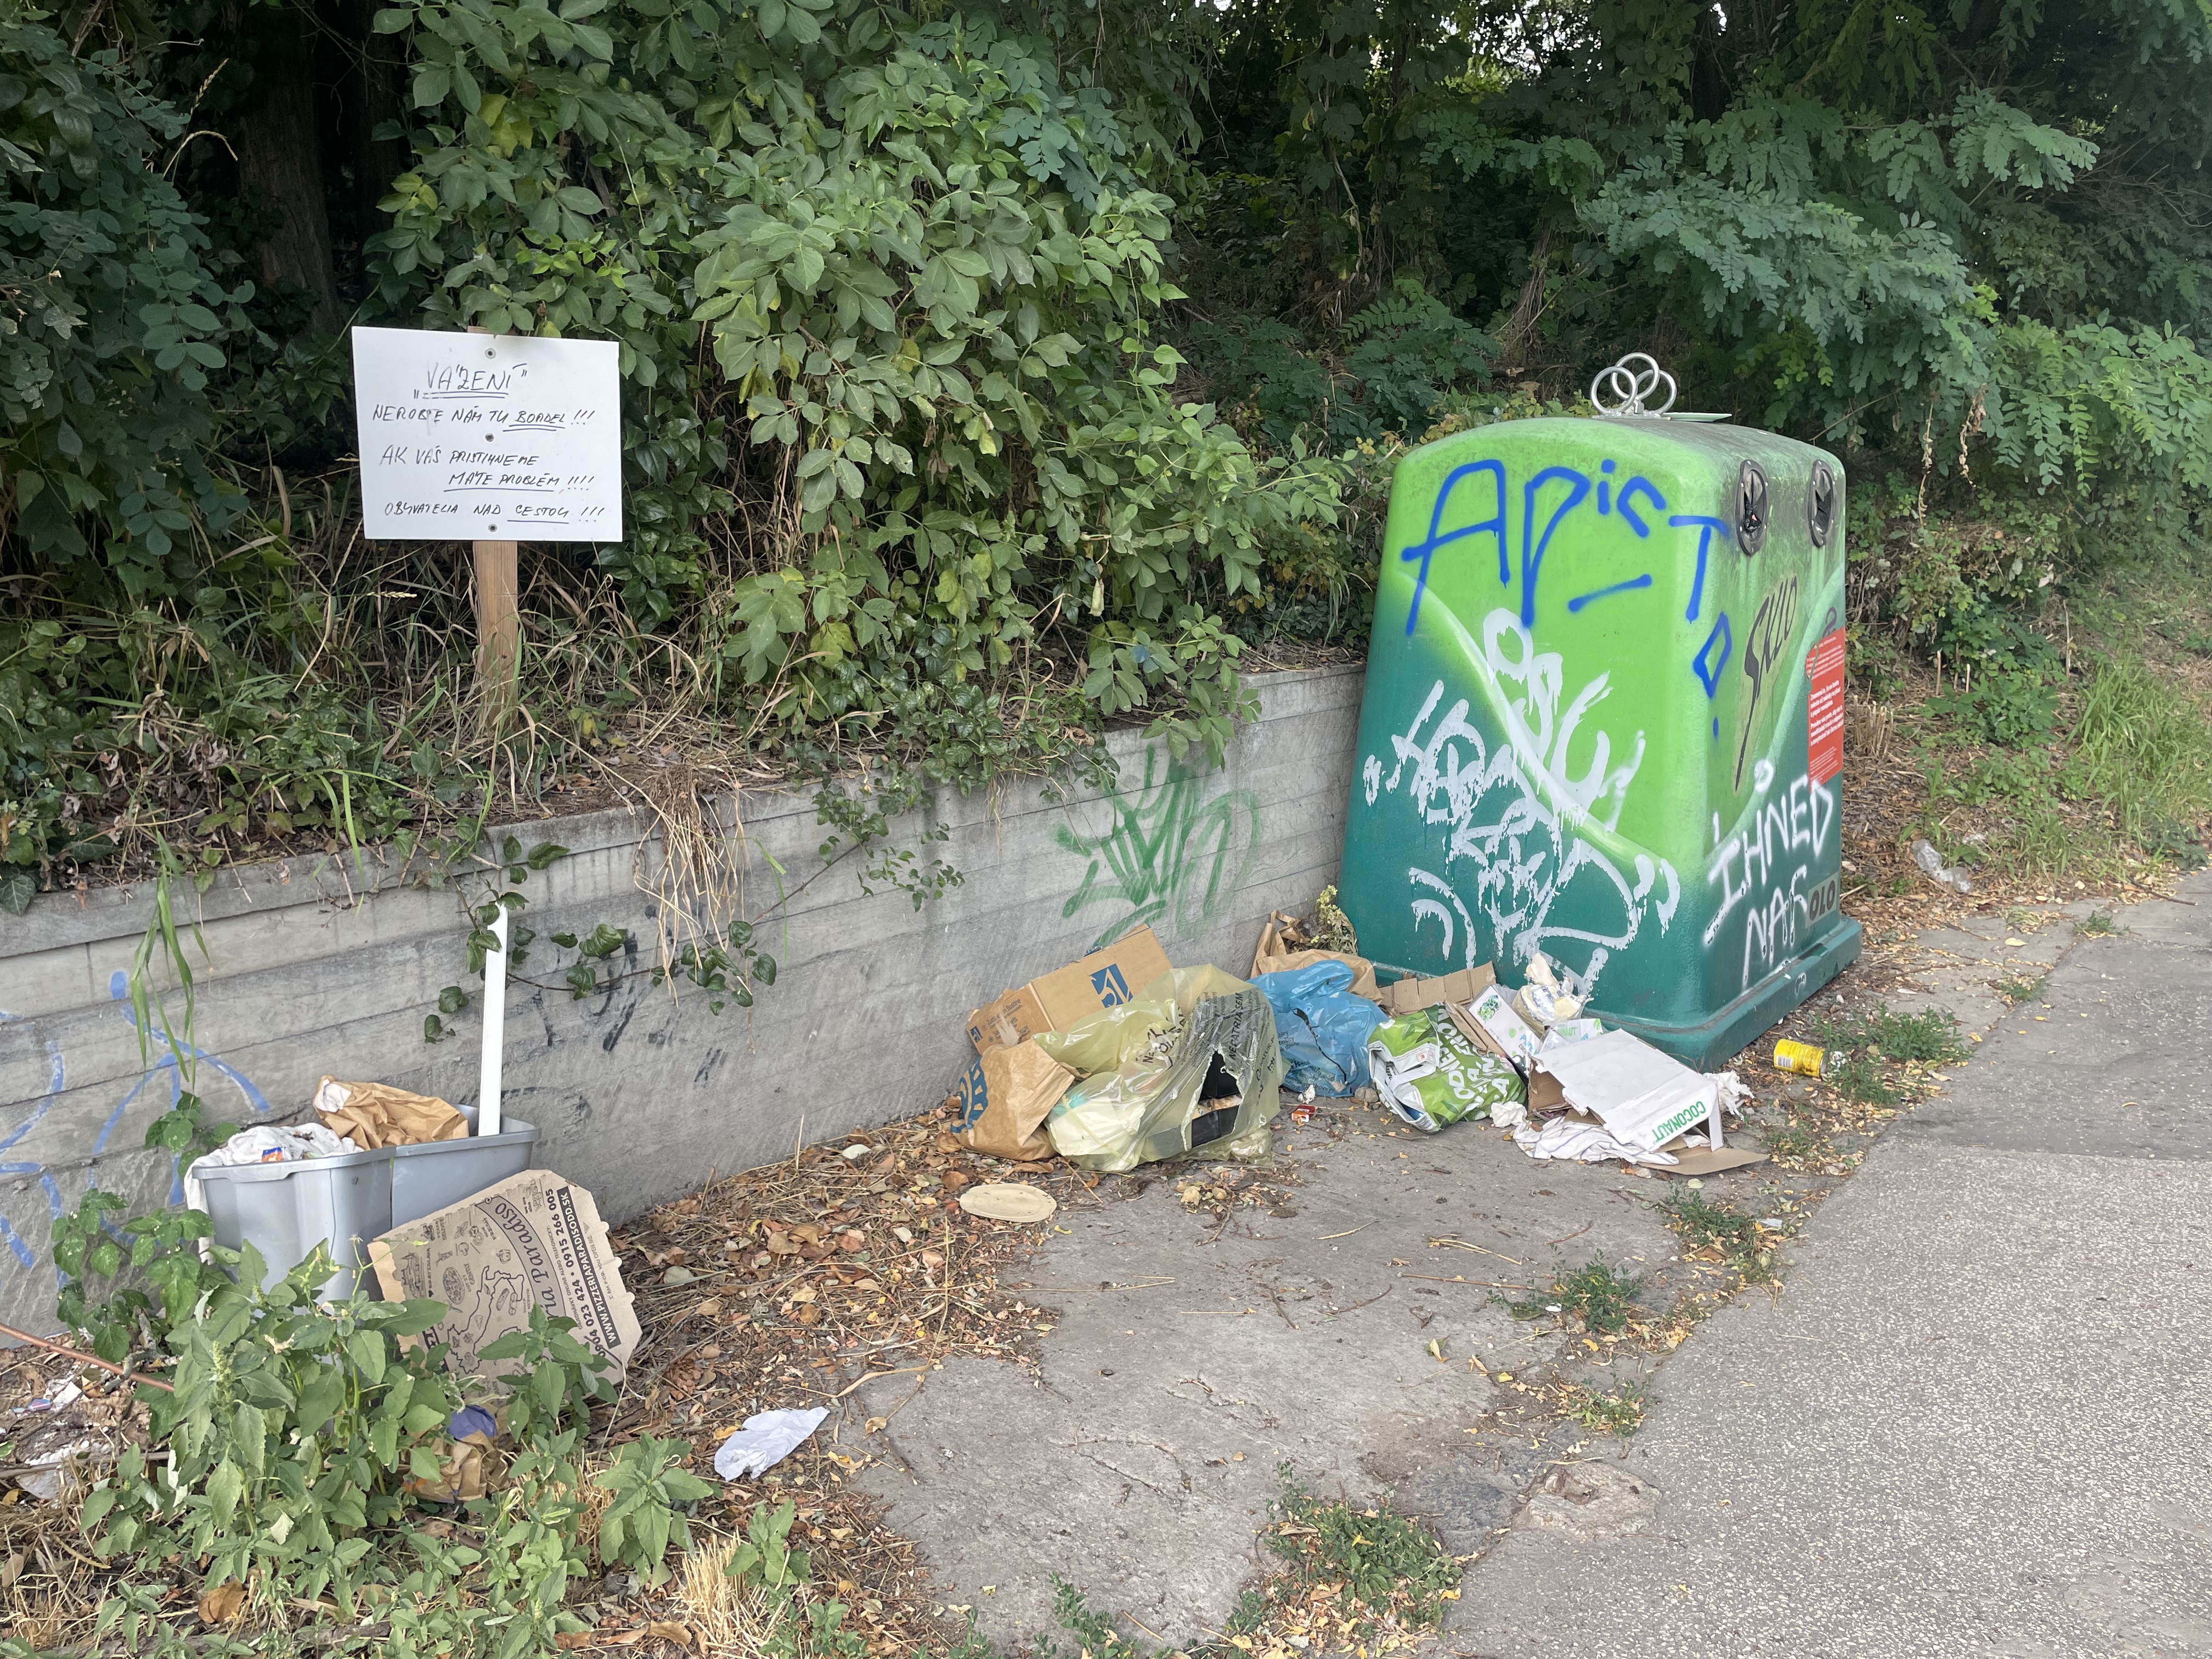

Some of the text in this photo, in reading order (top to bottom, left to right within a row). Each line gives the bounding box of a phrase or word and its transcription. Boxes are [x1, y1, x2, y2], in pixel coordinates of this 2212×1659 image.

[489, 411, 508, 423] TU
[515, 410, 566, 424] BORDEL
[380, 444, 408, 466] AK
[473, 505, 501, 515] NAD
[1810, 879, 1836, 921] OLO
[1652, 1101, 1706, 1142] COCONAUT
[544, 1188, 557, 1211] 005
[550, 1212, 565, 1235] 266
[495, 1202, 550, 1285] Paradiso
[558, 1238, 575, 1268] 0915
[560, 1192, 617, 1343] WWW.PIZZERIAPARADISODD.SK
[571, 1279, 585, 1302] 424
[579, 1304, 595, 1327] 023
